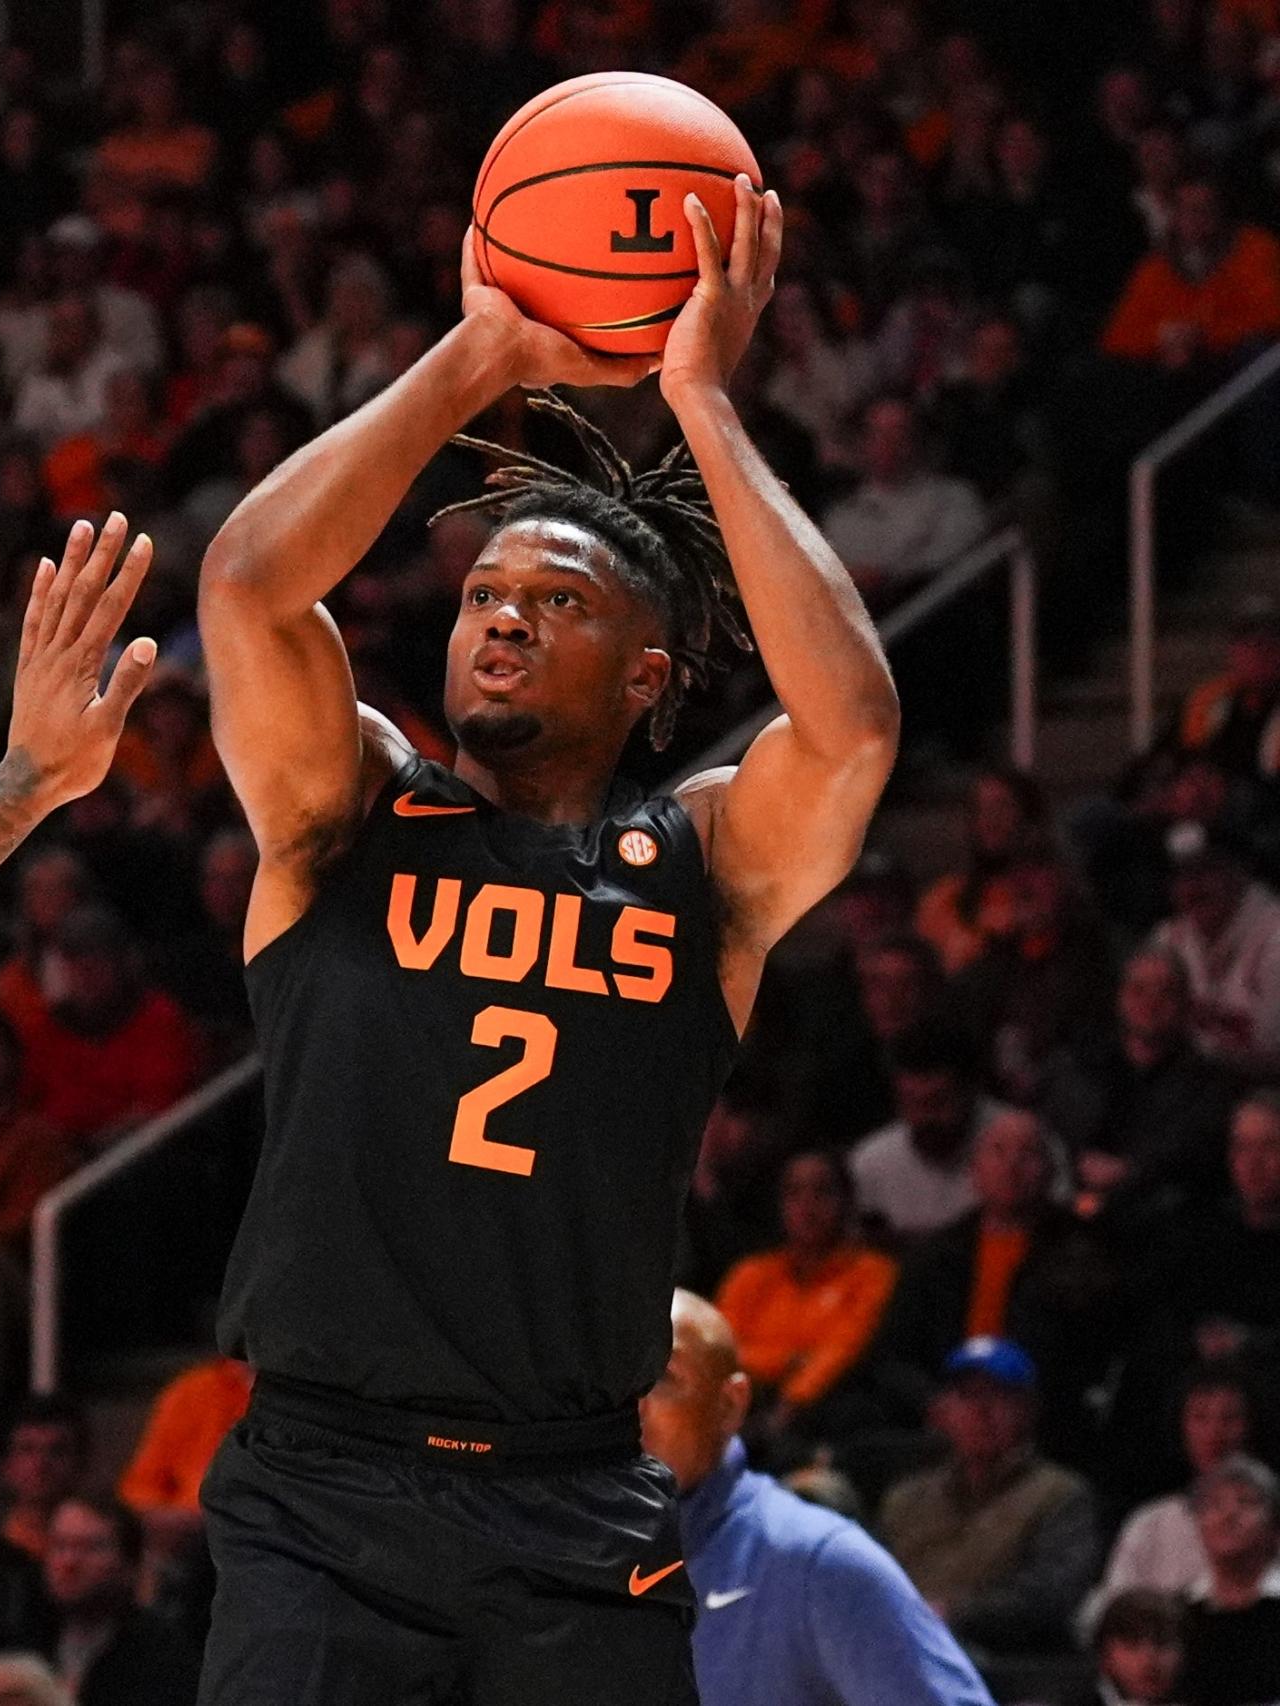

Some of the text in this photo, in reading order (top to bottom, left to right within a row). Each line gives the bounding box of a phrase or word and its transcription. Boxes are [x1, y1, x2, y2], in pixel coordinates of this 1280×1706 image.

[610, 188, 675, 253] T
[620, 831, 655, 865] SEC
[386, 872, 676, 1003] VOLS
[448, 1004, 558, 1177] 2
[427, 1435, 492, 1453] ROCKY TOP
